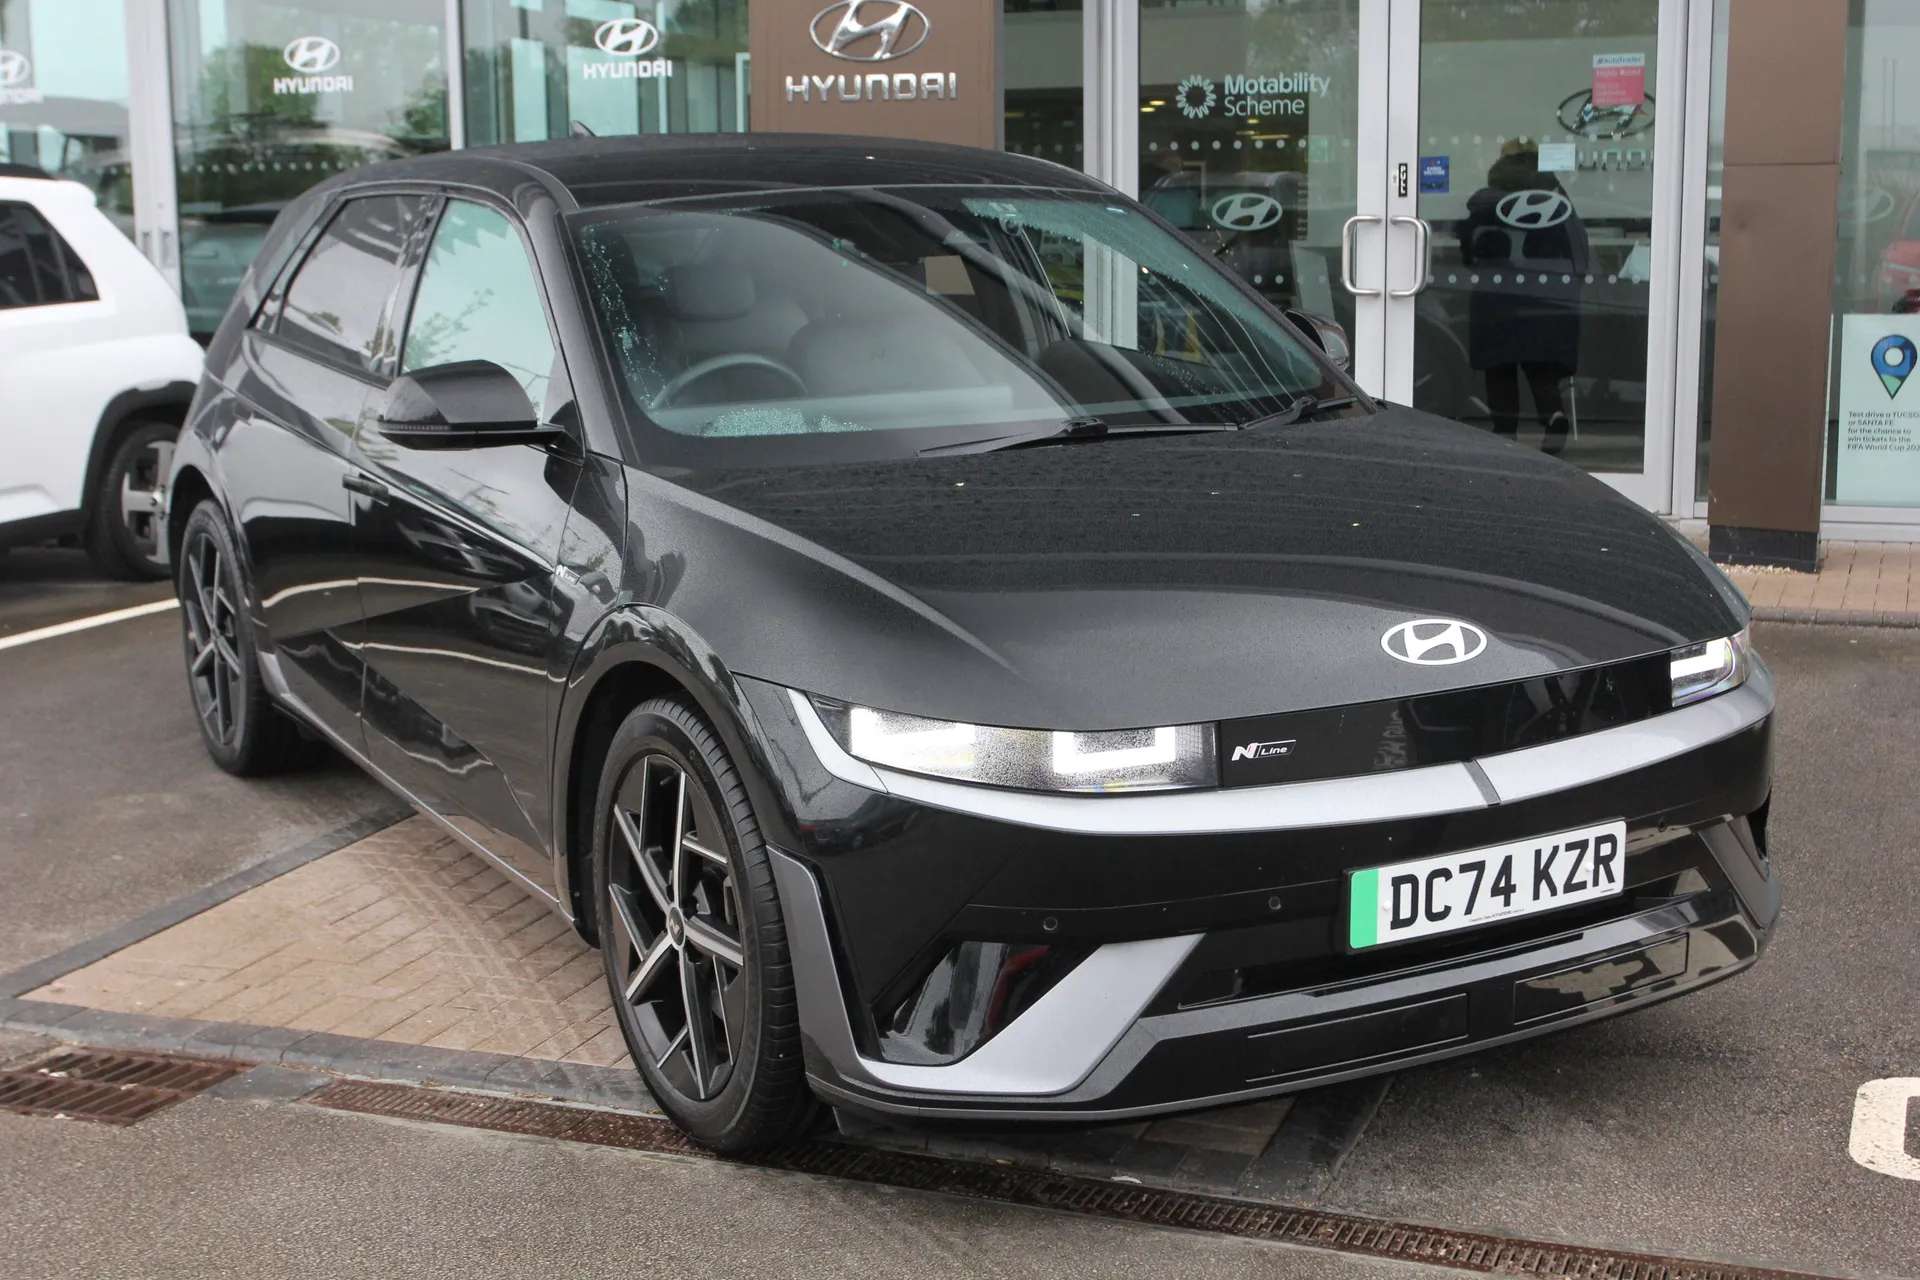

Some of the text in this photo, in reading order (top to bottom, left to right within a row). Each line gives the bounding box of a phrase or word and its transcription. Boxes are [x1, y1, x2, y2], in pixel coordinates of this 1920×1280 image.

[583, 60, 673, 79] HYUNDAI
[273, 75, 354, 95] HYUNDAI
[785, 72, 957, 102] HYUNDAI
[1224, 72, 1330, 98] Motability
[1224, 96, 1305, 116] Scheme
[1866, 410, 1885, 418] drive
[1231, 742, 1288, 761] N Line
[1390, 833, 1618, 930] DC74 KZR
